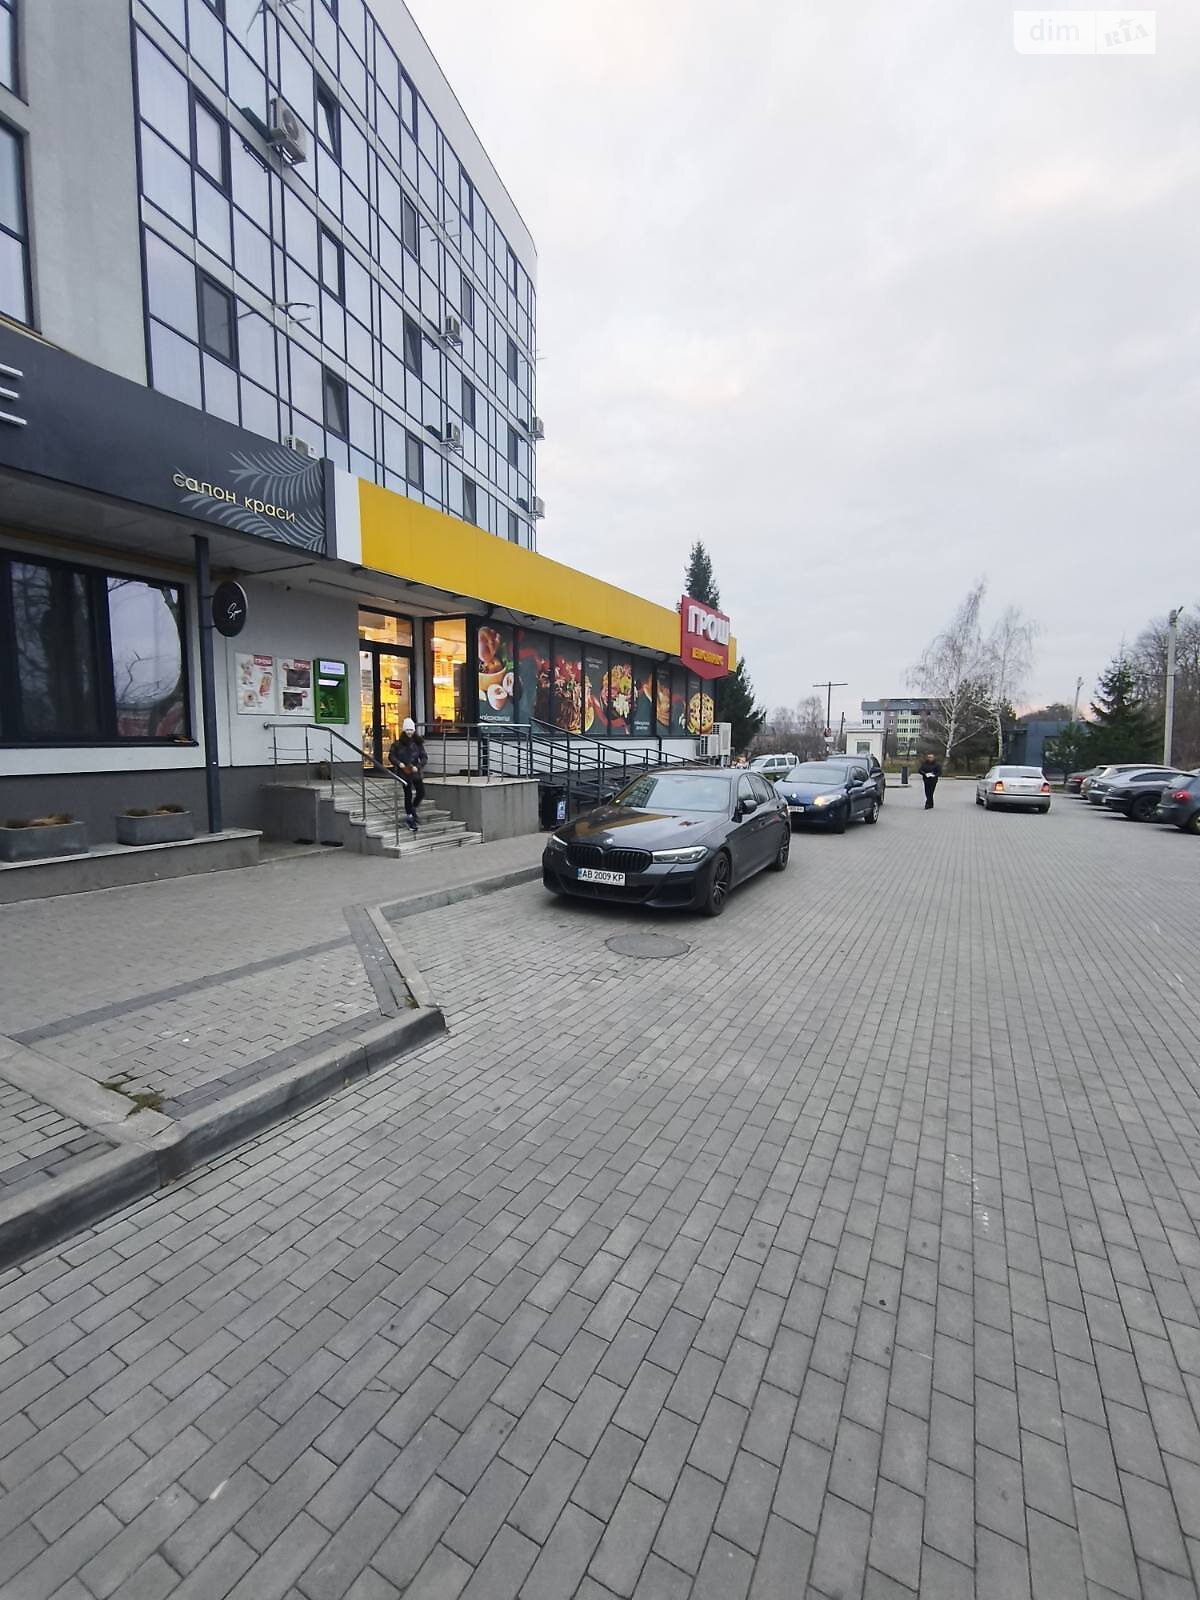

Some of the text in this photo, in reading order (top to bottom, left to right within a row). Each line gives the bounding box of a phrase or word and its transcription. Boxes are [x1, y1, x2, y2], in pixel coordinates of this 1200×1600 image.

[172, 473, 296, 523] салон краси
[582, 870, 624, 882] AB 2009 KP
